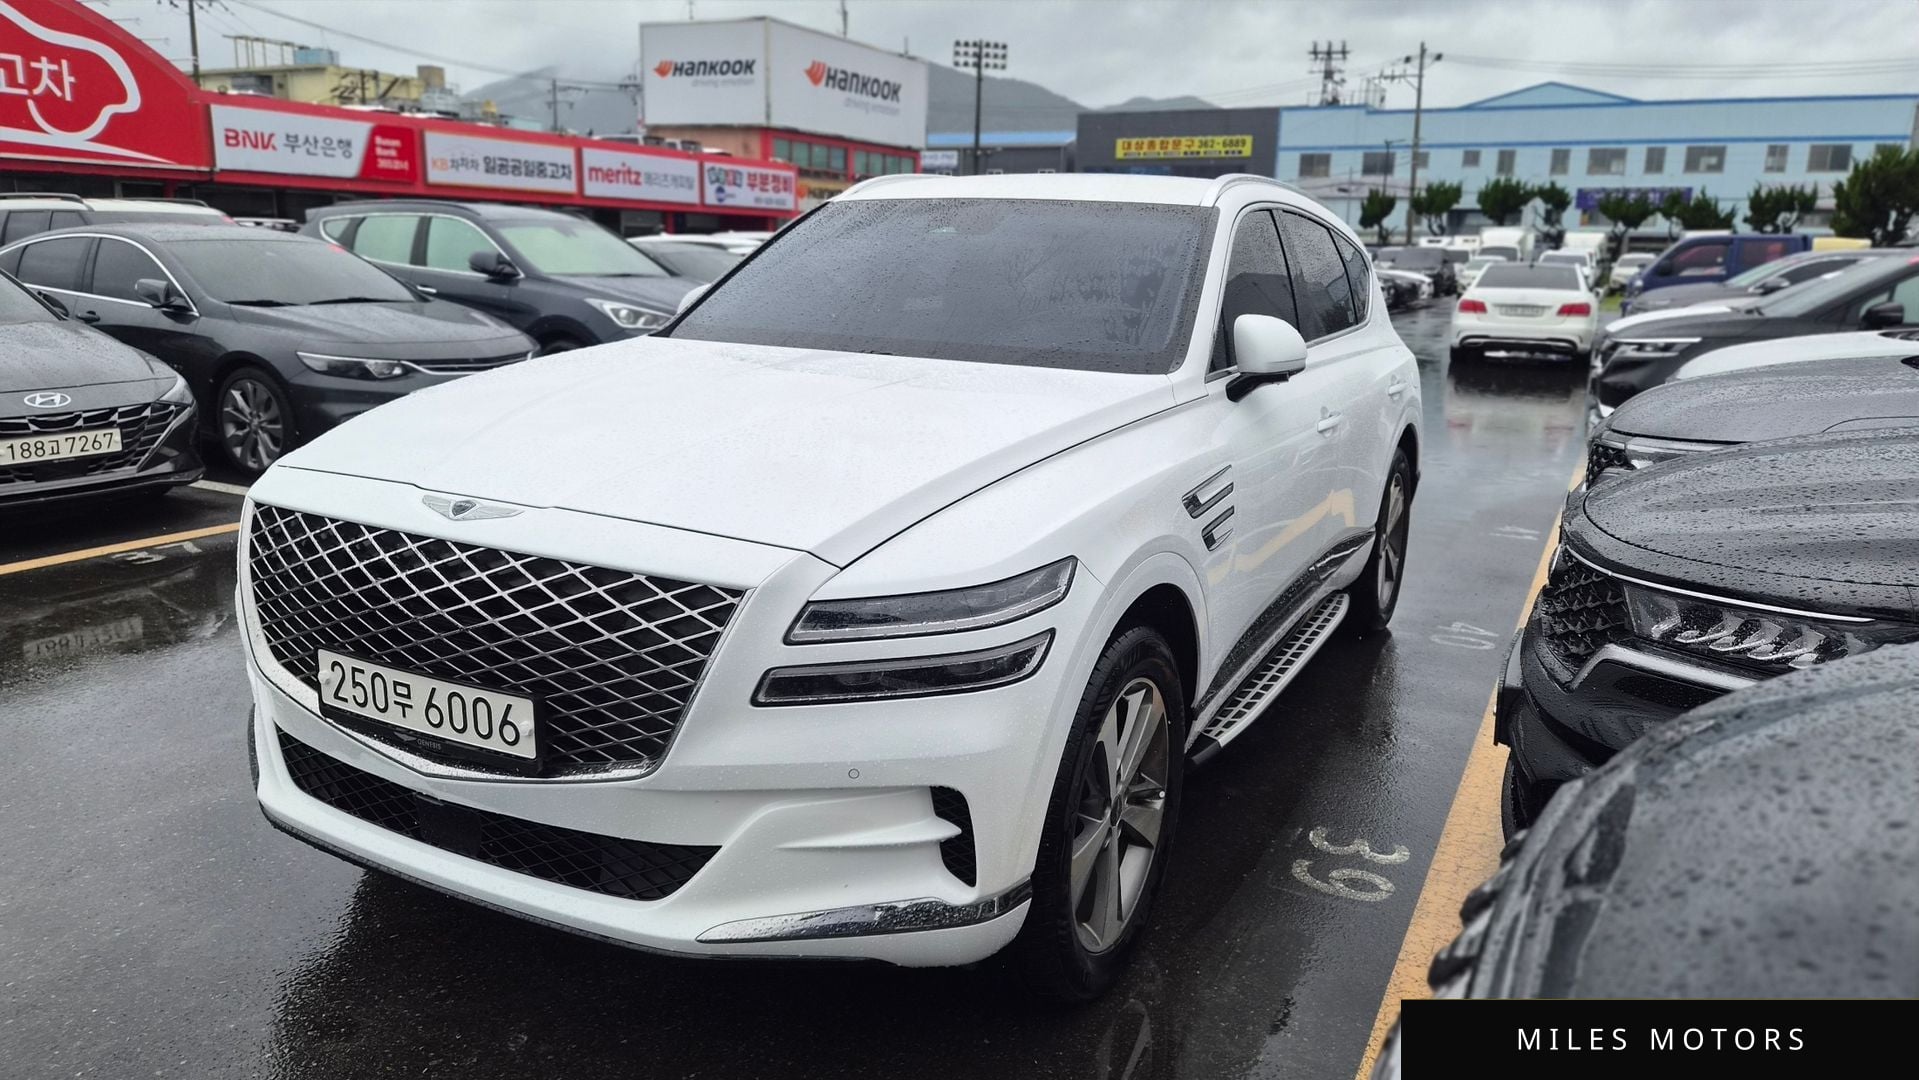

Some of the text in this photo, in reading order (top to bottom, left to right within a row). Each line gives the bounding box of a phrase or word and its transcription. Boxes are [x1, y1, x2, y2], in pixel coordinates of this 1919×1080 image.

[224, 128, 353, 159] BNK 부산은행
[483, 156, 572, 181] 일공공일중고차
[588, 161, 642, 187] meritz
[6, 432, 114, 461] 188고 7267
[330, 660, 521, 747] 250무 6006
[417, 738, 442, 751] GENESIS
[1291, 826, 1411, 902] 39
